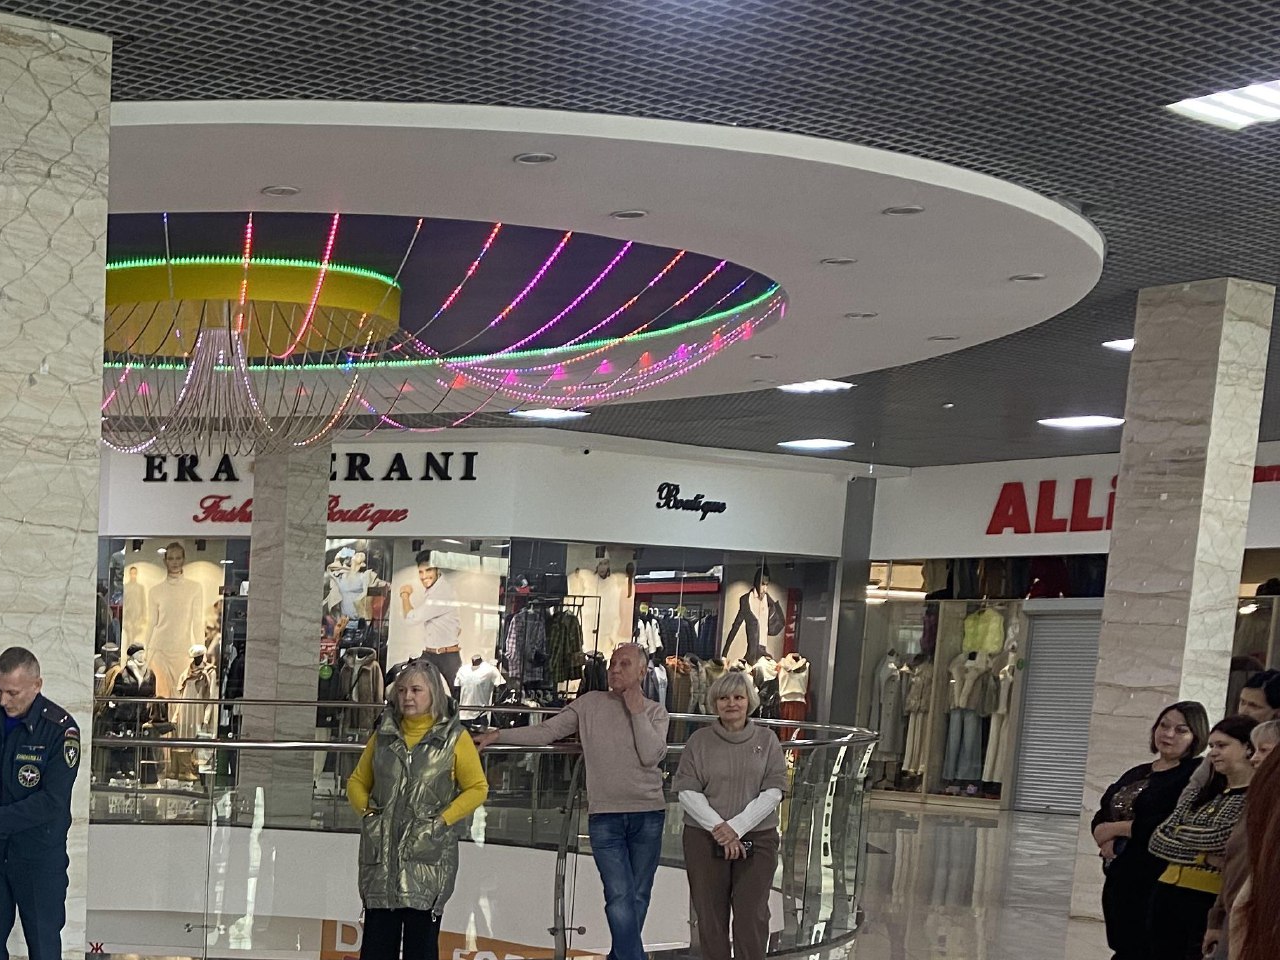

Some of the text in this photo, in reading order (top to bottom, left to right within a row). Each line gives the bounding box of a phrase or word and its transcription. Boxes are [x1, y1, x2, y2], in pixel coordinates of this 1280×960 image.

[143, 453, 240, 482] ERA
[329, 451, 479, 481] RANI
[656, 482, 727, 521] Boutique
